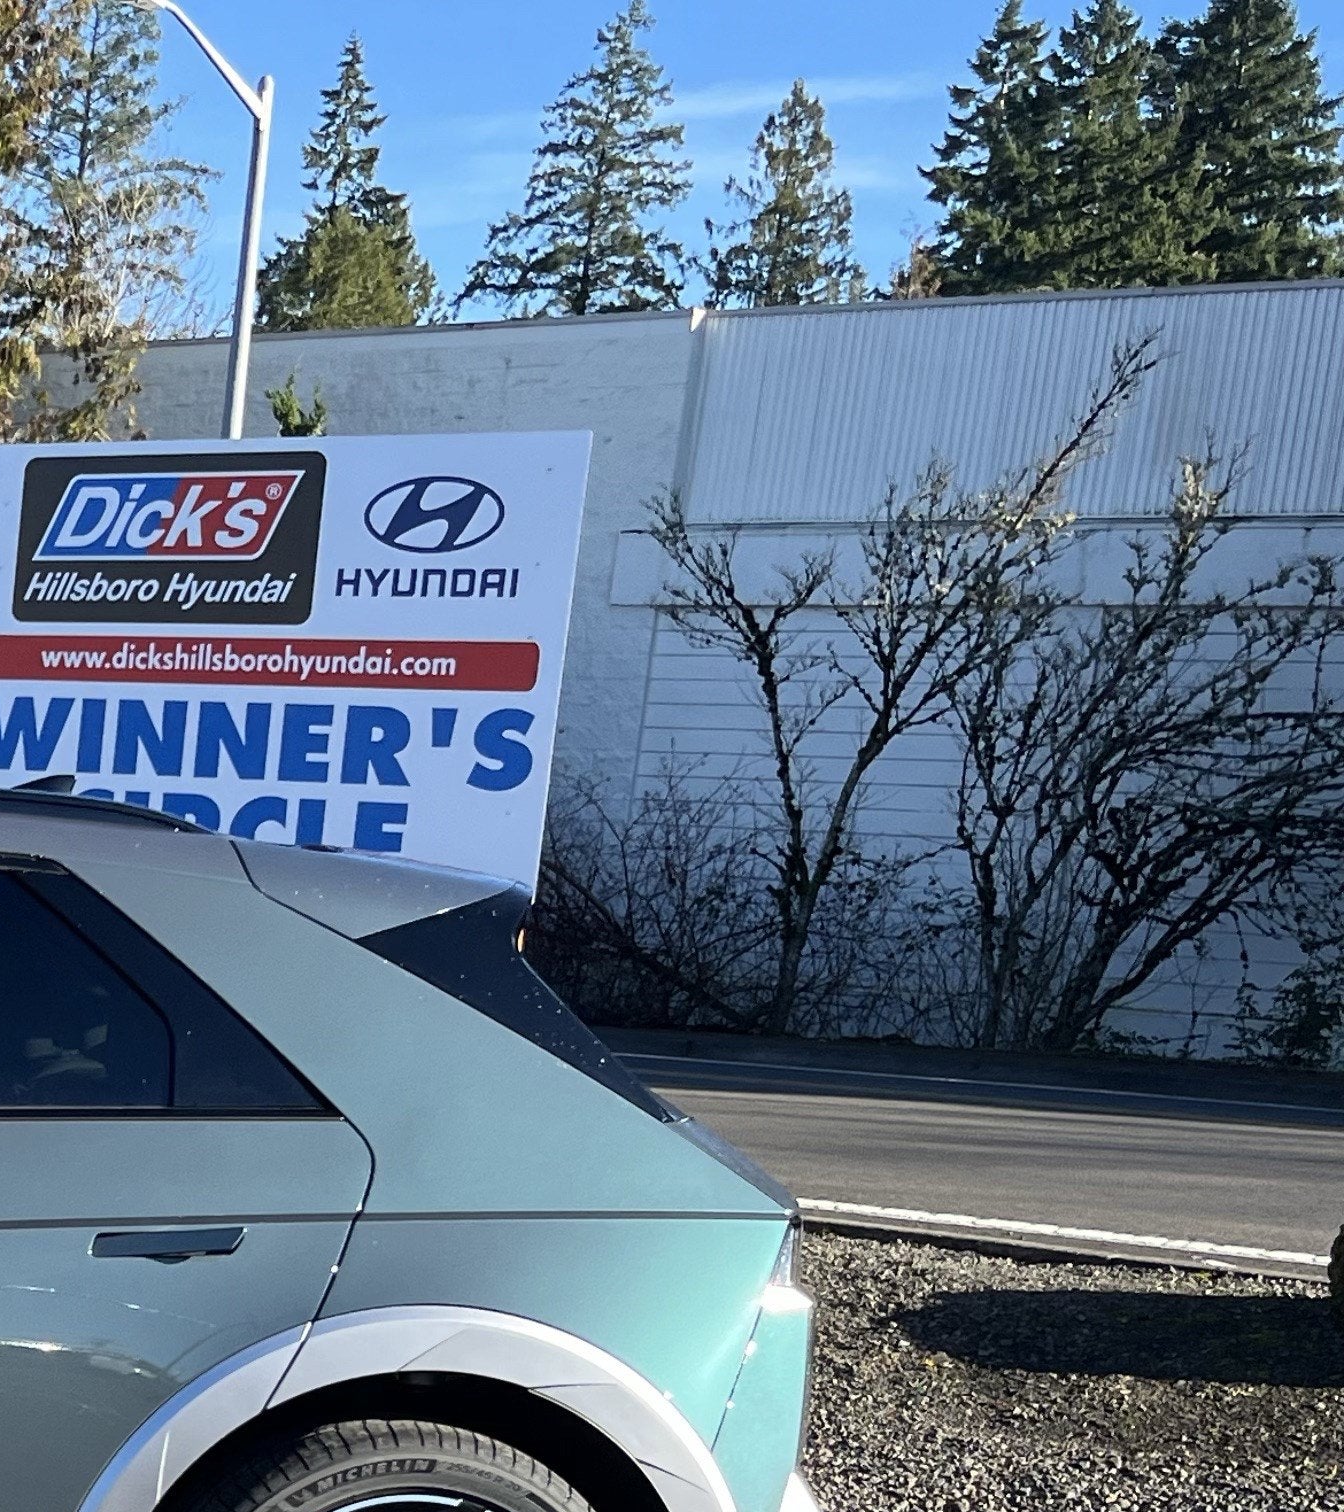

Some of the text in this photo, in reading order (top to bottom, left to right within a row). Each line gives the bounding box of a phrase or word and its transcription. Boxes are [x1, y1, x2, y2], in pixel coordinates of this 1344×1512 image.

[53, 480, 268, 549] Dick's
[23, 571, 297, 611] Hillsboro Hyundai
[335, 566, 519, 599] HYUNDAI
[40, 642, 457, 681] www.dickshillsborohyundai.com
[74, 788, 409, 853] CLE
[316, 1458, 431, 1493] MICHELIN
